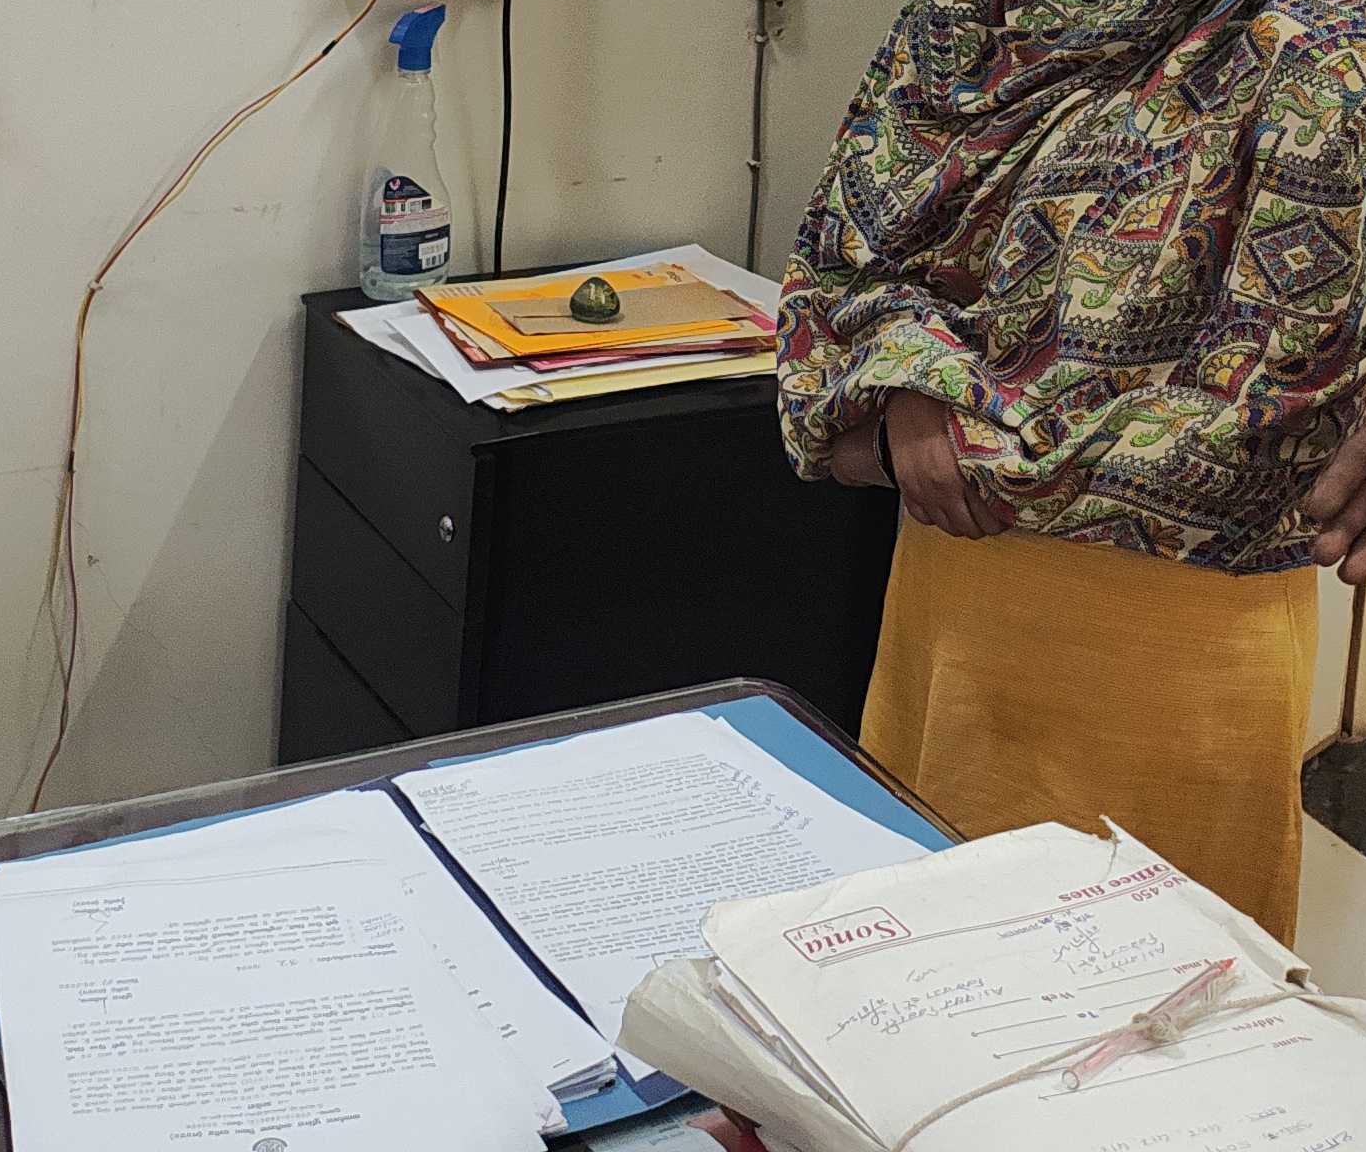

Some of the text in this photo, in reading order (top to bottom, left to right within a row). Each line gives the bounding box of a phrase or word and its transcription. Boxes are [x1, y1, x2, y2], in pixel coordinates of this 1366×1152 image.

[1058, 860, 1172, 905] Office files
[1129, 874, 1190, 903] No.450
[803, 918, 897, 960] Sonia
[1230, 1014, 1284, 1035] Address
[1272, 1033, 1313, 1051] Name
